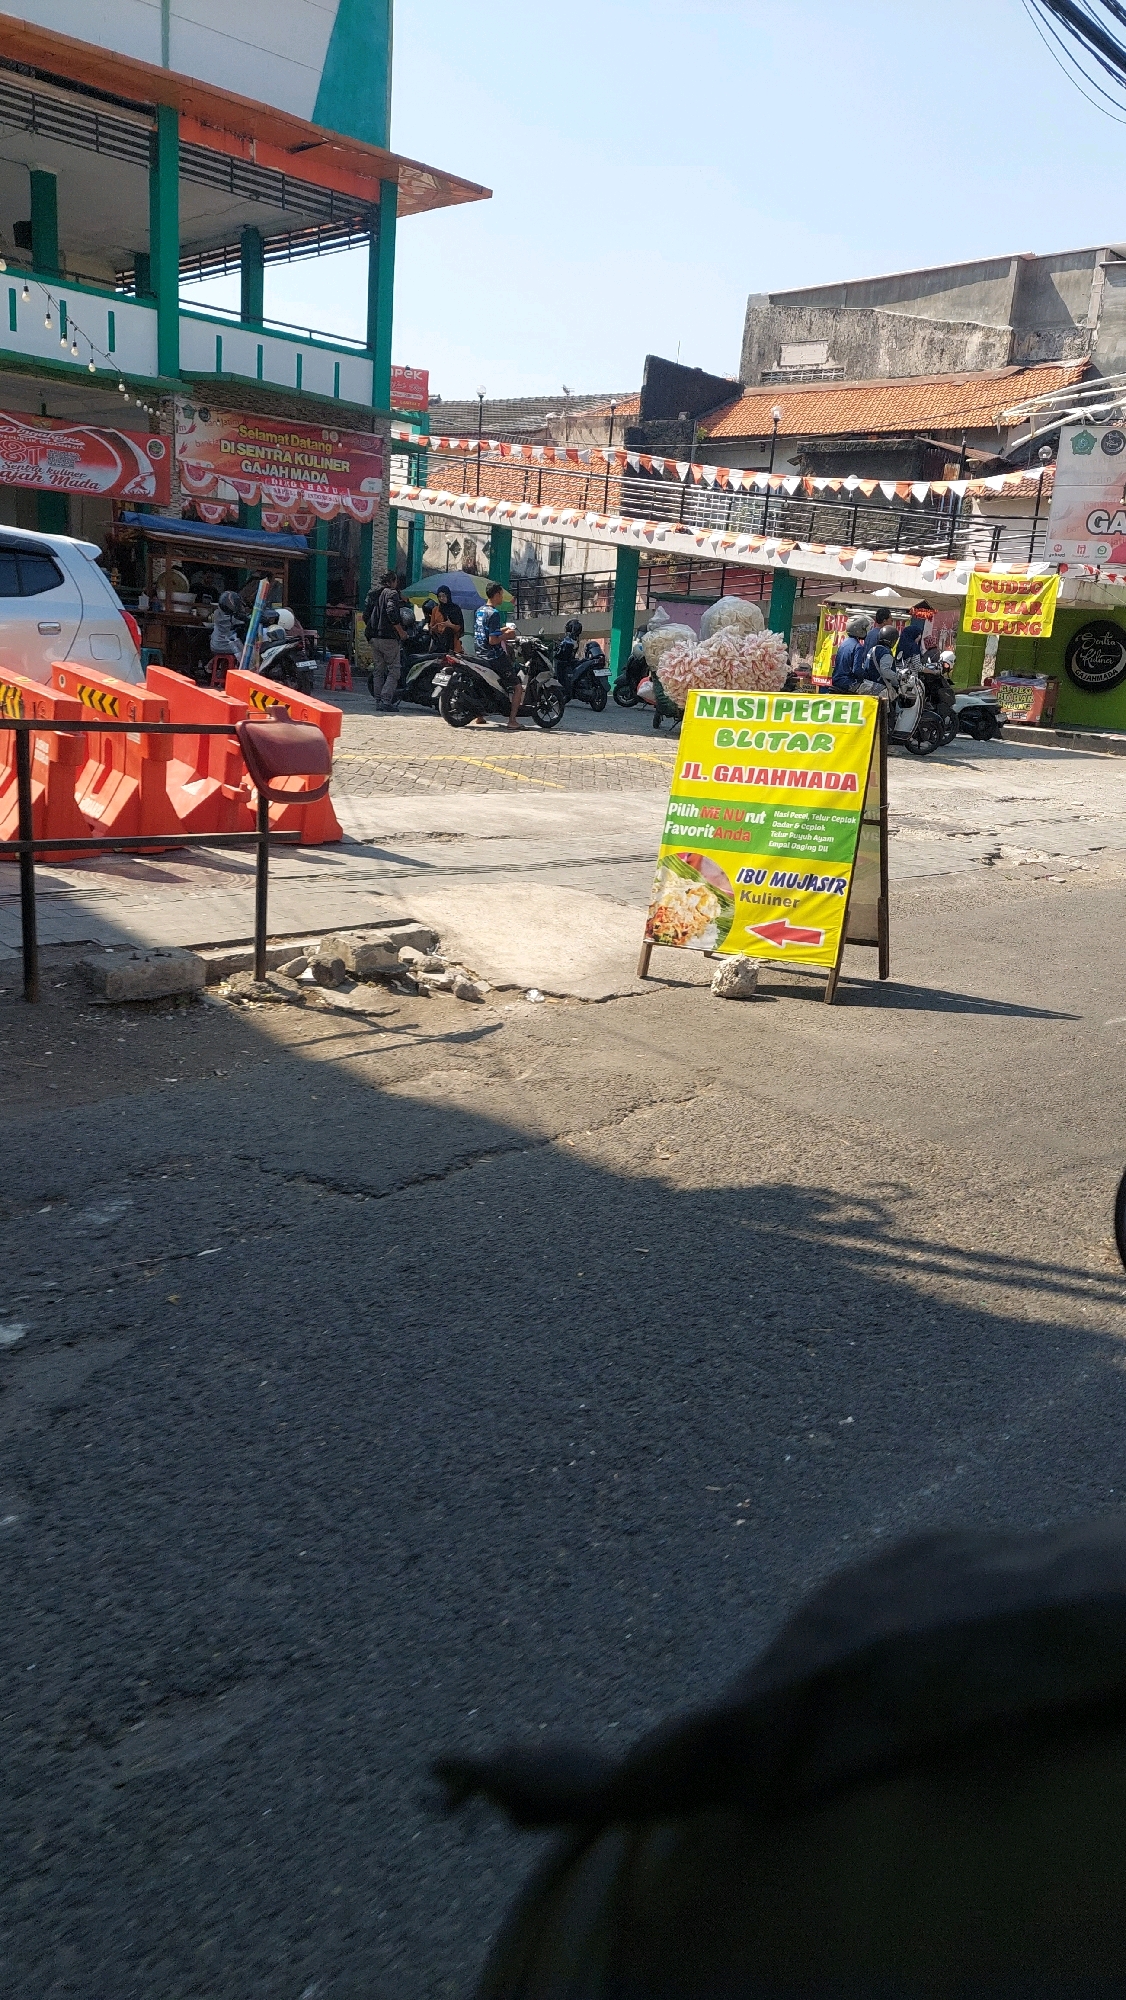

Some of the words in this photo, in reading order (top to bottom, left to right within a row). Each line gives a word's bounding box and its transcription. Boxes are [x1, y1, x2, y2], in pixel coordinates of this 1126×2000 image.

[39, 440, 85, 450] INDONESIA
[238, 424, 290, 446] Selamat
[290, 434, 333, 455] Datang
[220, 439, 236, 455] DI
[236, 442, 293, 463] SENTRA
[294, 452, 350, 473] KULINER
[241, 459, 289, 479] GAJAH
[290, 467, 329, 485] MADA
[49, 474, 101, 490] Mada
[980, 579, 1044, 595] GUDEG
[976, 599, 1001, 613] BU
[1003, 601, 1042, 615] HAR
[971, 618, 1042, 635] SULUNG
[1075, 669, 1118, 682] GAJAHMADA
[696, 695, 766, 721] NASI
[773, 698, 864, 725] PECEL
[716, 729, 833, 752] BLITAR
[681, 762, 708, 781] JL.
[714, 765, 857, 791] GAJAHMADA
[668, 802, 700, 818] Pilih
[773, 810, 789, 818] Nasi
[811, 813, 830, 822] Telur
[831, 815, 856, 824] Ceplok
[770, 830, 788, 838] Telur
[788, 832, 812, 841] Puyuh
[812, 834, 834, 843] Ayam
[768, 840, 790, 849] Empal
[791, 842, 817, 853] Daging
[736, 867, 768, 886] IBU
[769, 870, 848, 896] MUJASIR
[739, 889, 801, 909] Kuliner
